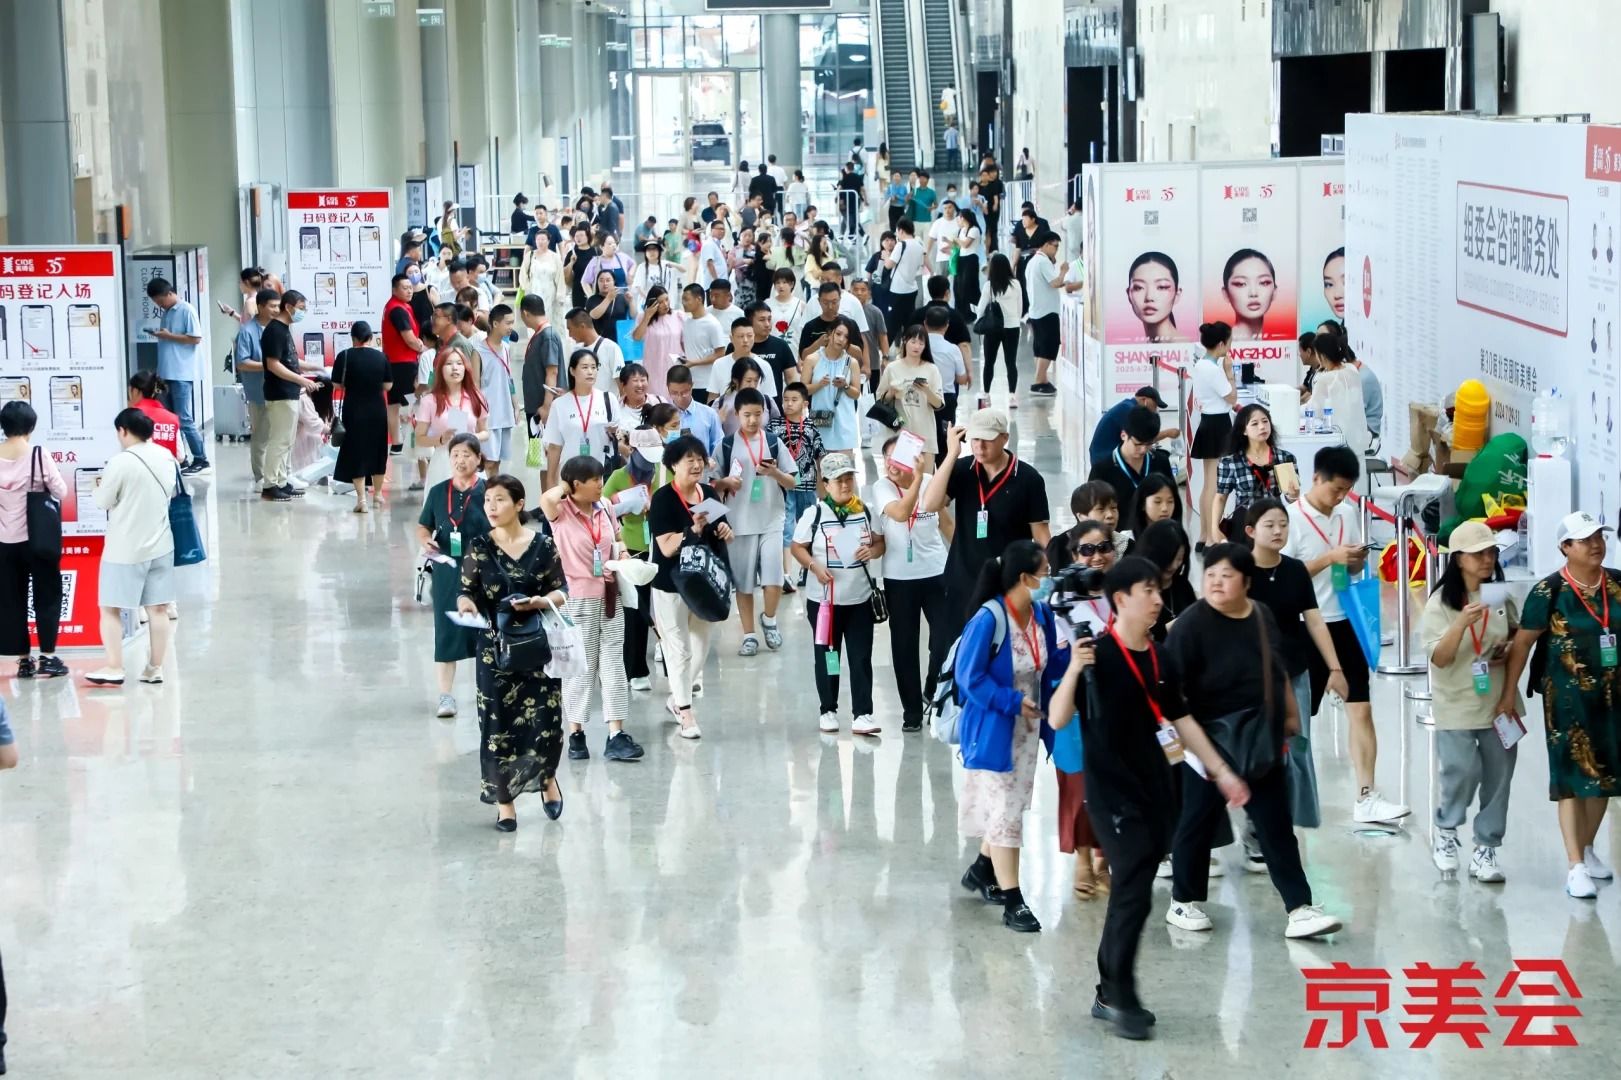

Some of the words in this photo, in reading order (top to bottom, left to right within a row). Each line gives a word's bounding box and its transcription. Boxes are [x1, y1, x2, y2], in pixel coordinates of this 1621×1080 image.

[304, 213, 375, 223] 扫码登记入场
[1464, 202, 1560, 279] 组委会咨询服务处
